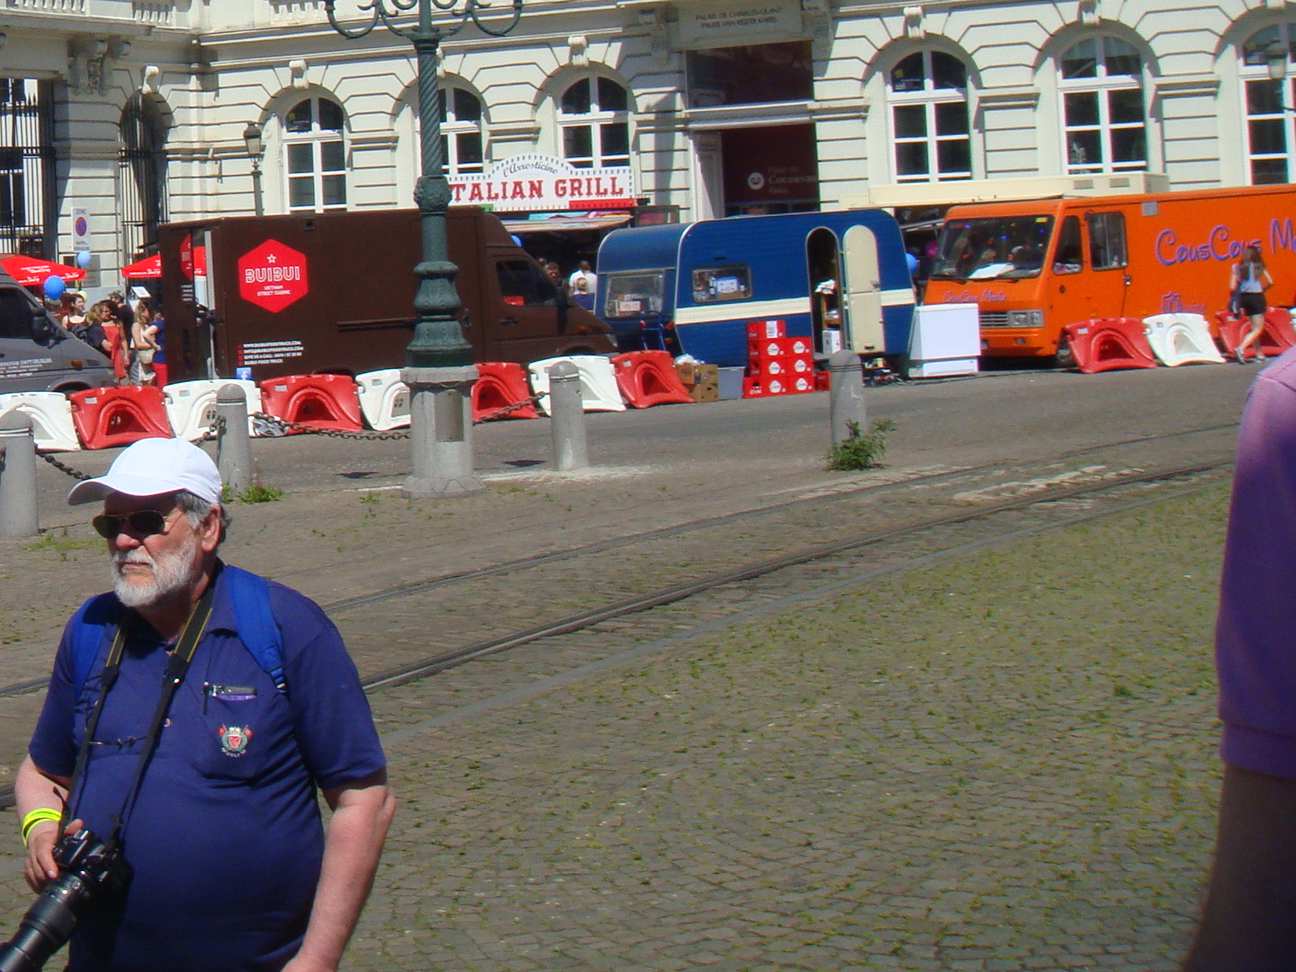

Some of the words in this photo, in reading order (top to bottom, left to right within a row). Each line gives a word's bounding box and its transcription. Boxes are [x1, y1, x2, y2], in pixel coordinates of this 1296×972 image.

[449, 179, 544, 202] TALIAN
[554, 176, 624, 198] GRILL
[245, 266, 300, 283] BUIBUI
